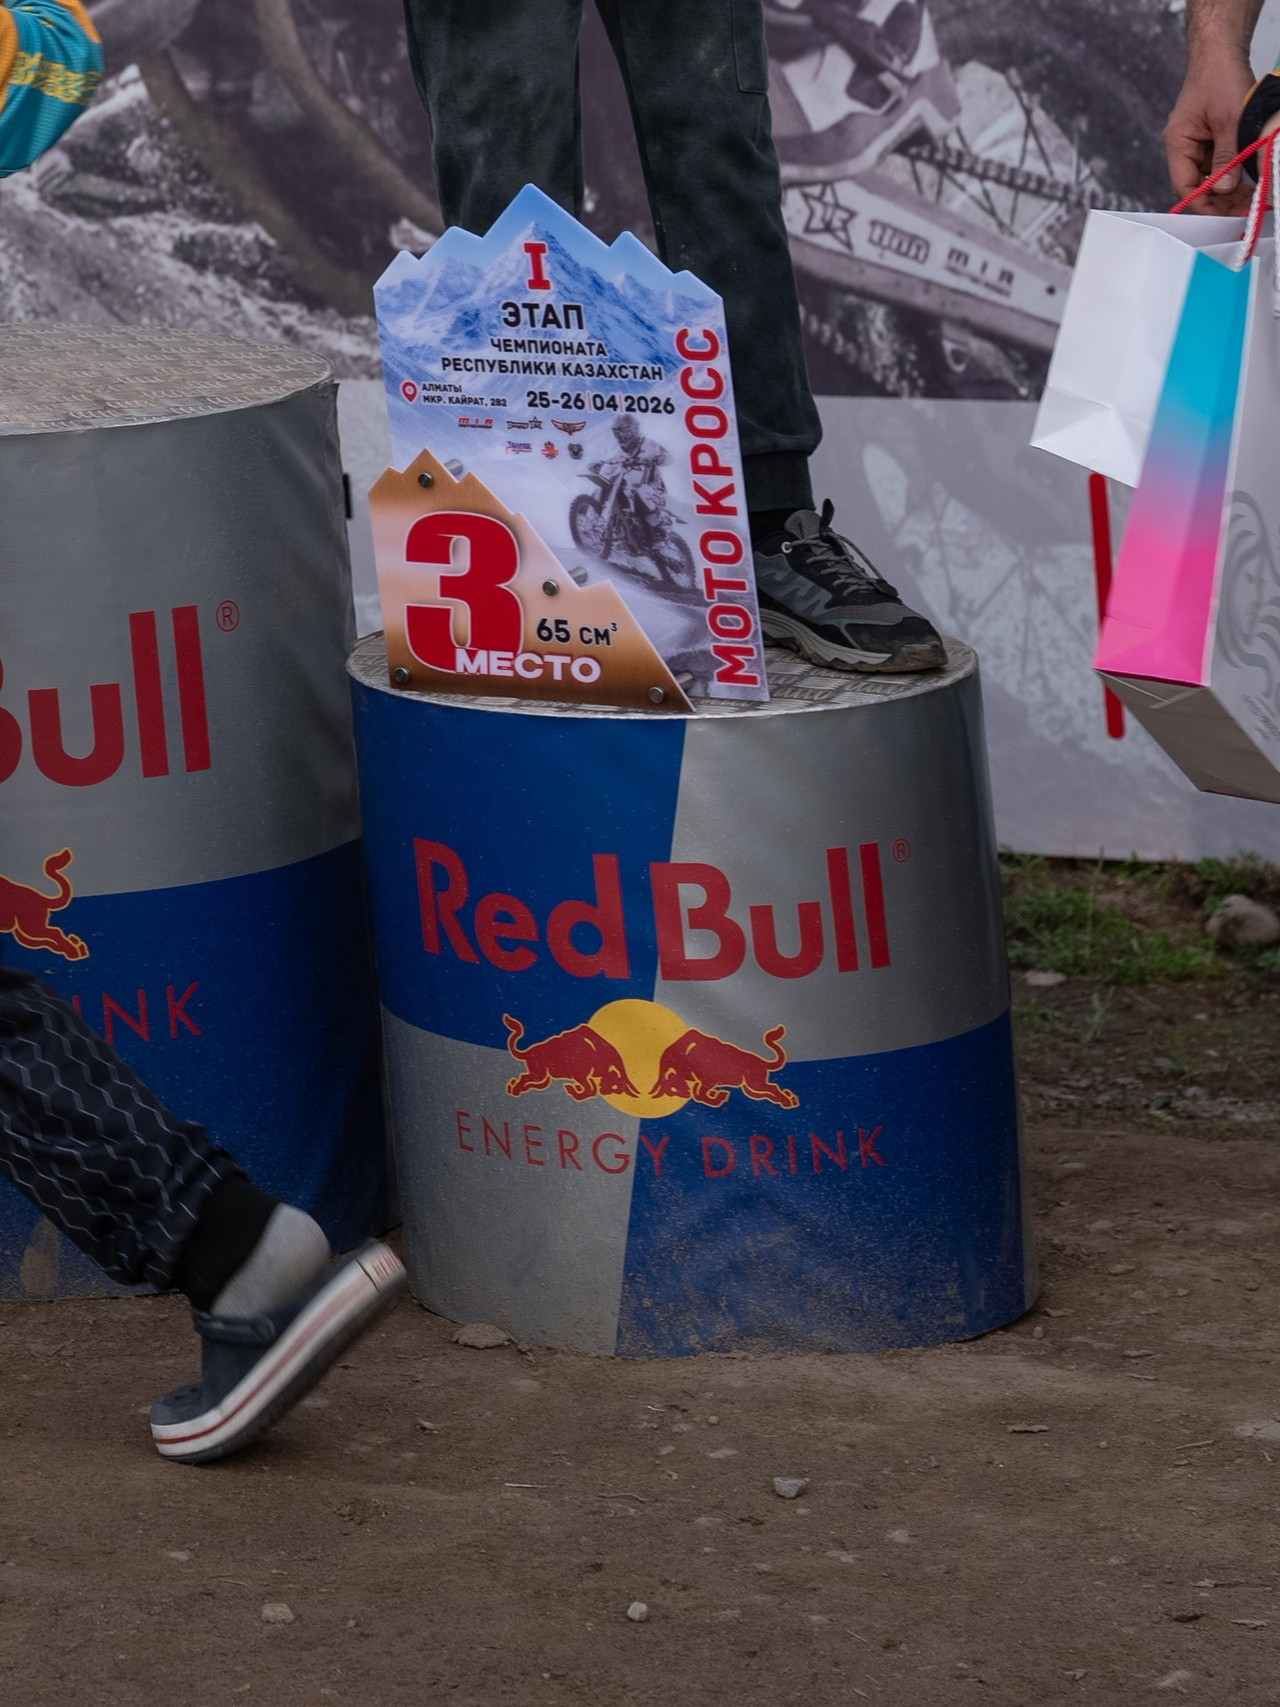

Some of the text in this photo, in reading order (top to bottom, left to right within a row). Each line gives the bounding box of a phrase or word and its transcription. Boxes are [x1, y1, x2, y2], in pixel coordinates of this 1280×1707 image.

[524, 242, 552, 291] I
[501, 300, 585, 330] ЭТАП
[490, 337, 609, 357] ЧЕМПИОНАТА
[441, 356, 664, 382] РЕСПУБЛИКИ КАЗАХСТАН
[421, 382, 463, 394] АЛМАТЫ
[422, 394, 508, 408] МКР. КАЙРАТ, 282
[526, 390, 676, 415] 25-26 04 2026
[674, 327, 761, 688] МОТО КРОСС
[404, 510, 524, 676] 3
[535, 618, 572, 644] 65
[455, 646, 602, 684] МЕСТО
[413, 836, 631, 980] Red
[649, 841, 892, 981] Bull
[455, 1109, 888, 1178] ENERGY DRINK
